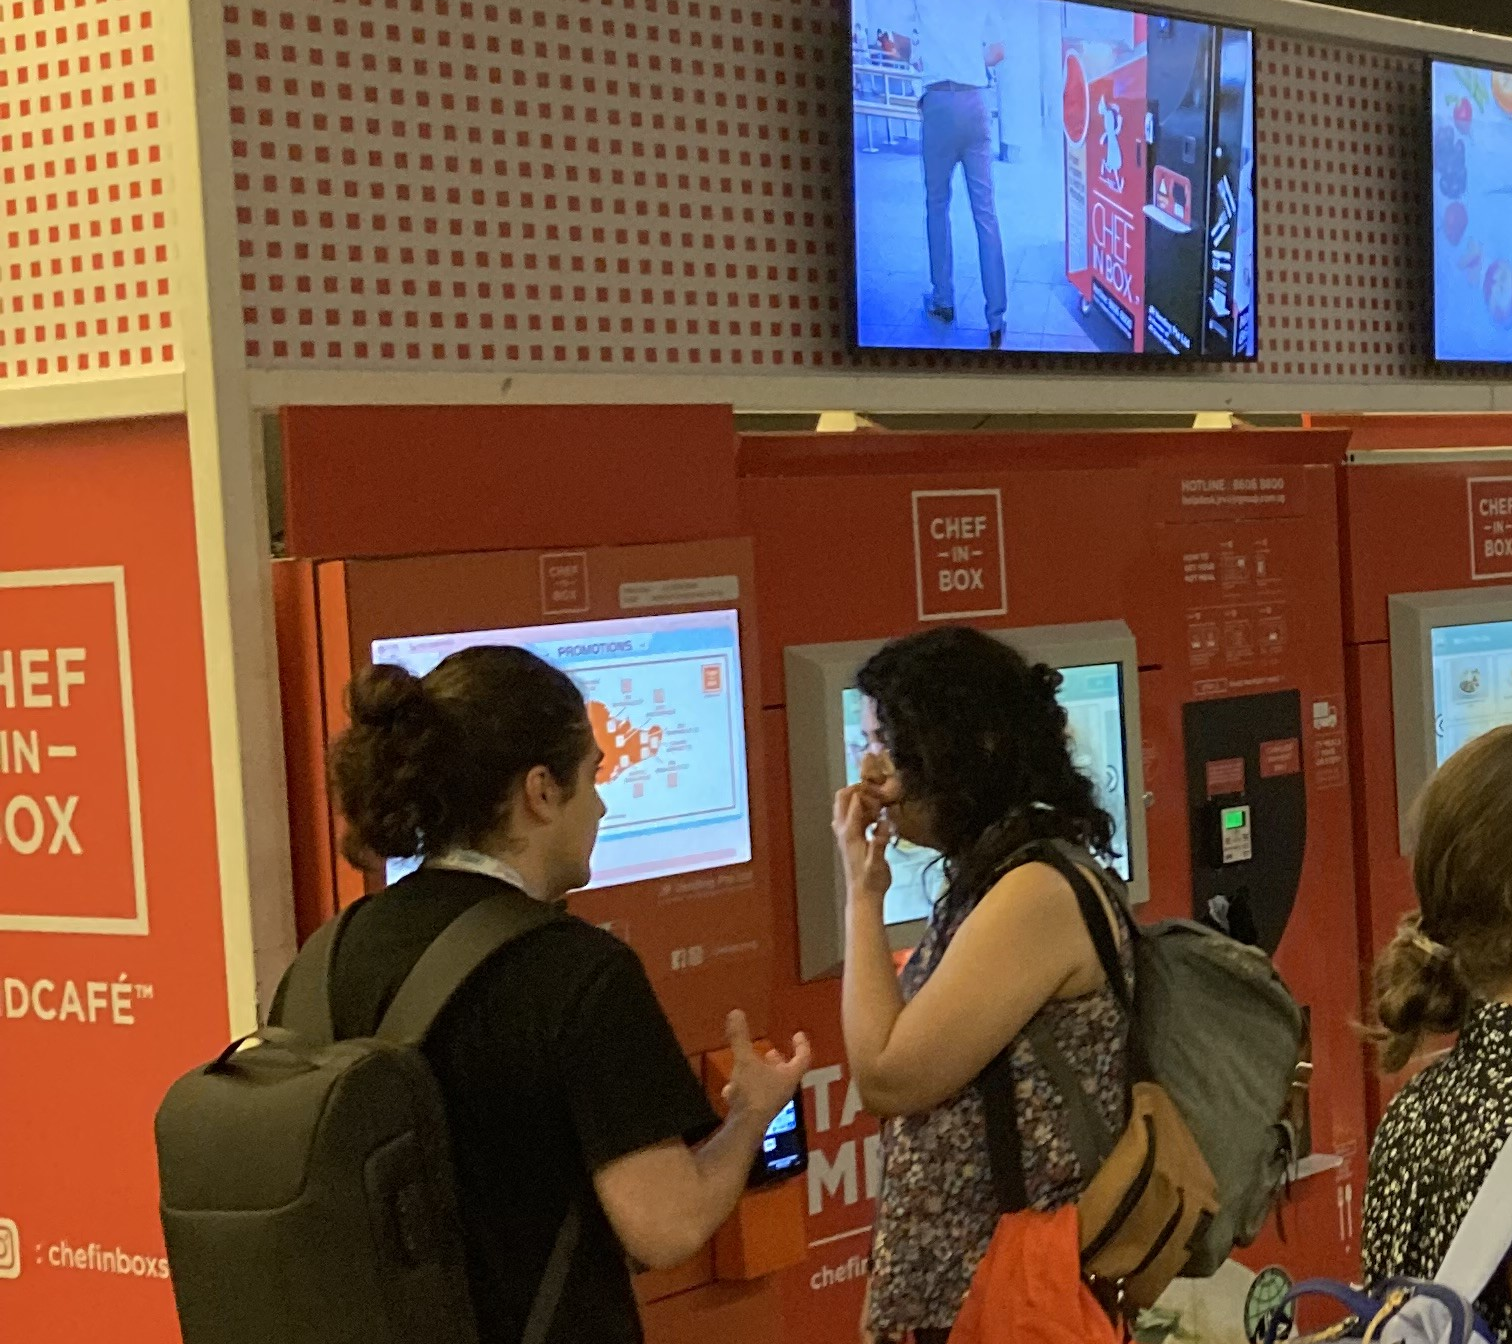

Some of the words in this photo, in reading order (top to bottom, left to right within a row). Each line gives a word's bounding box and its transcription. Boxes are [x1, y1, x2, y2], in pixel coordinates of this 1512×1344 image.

[930, 516, 987, 540] CHEF
[939, 568, 984, 592] BOX
[558, 640, 633, 657] PROMOTIONS
[0, 795, 83, 855] OX
